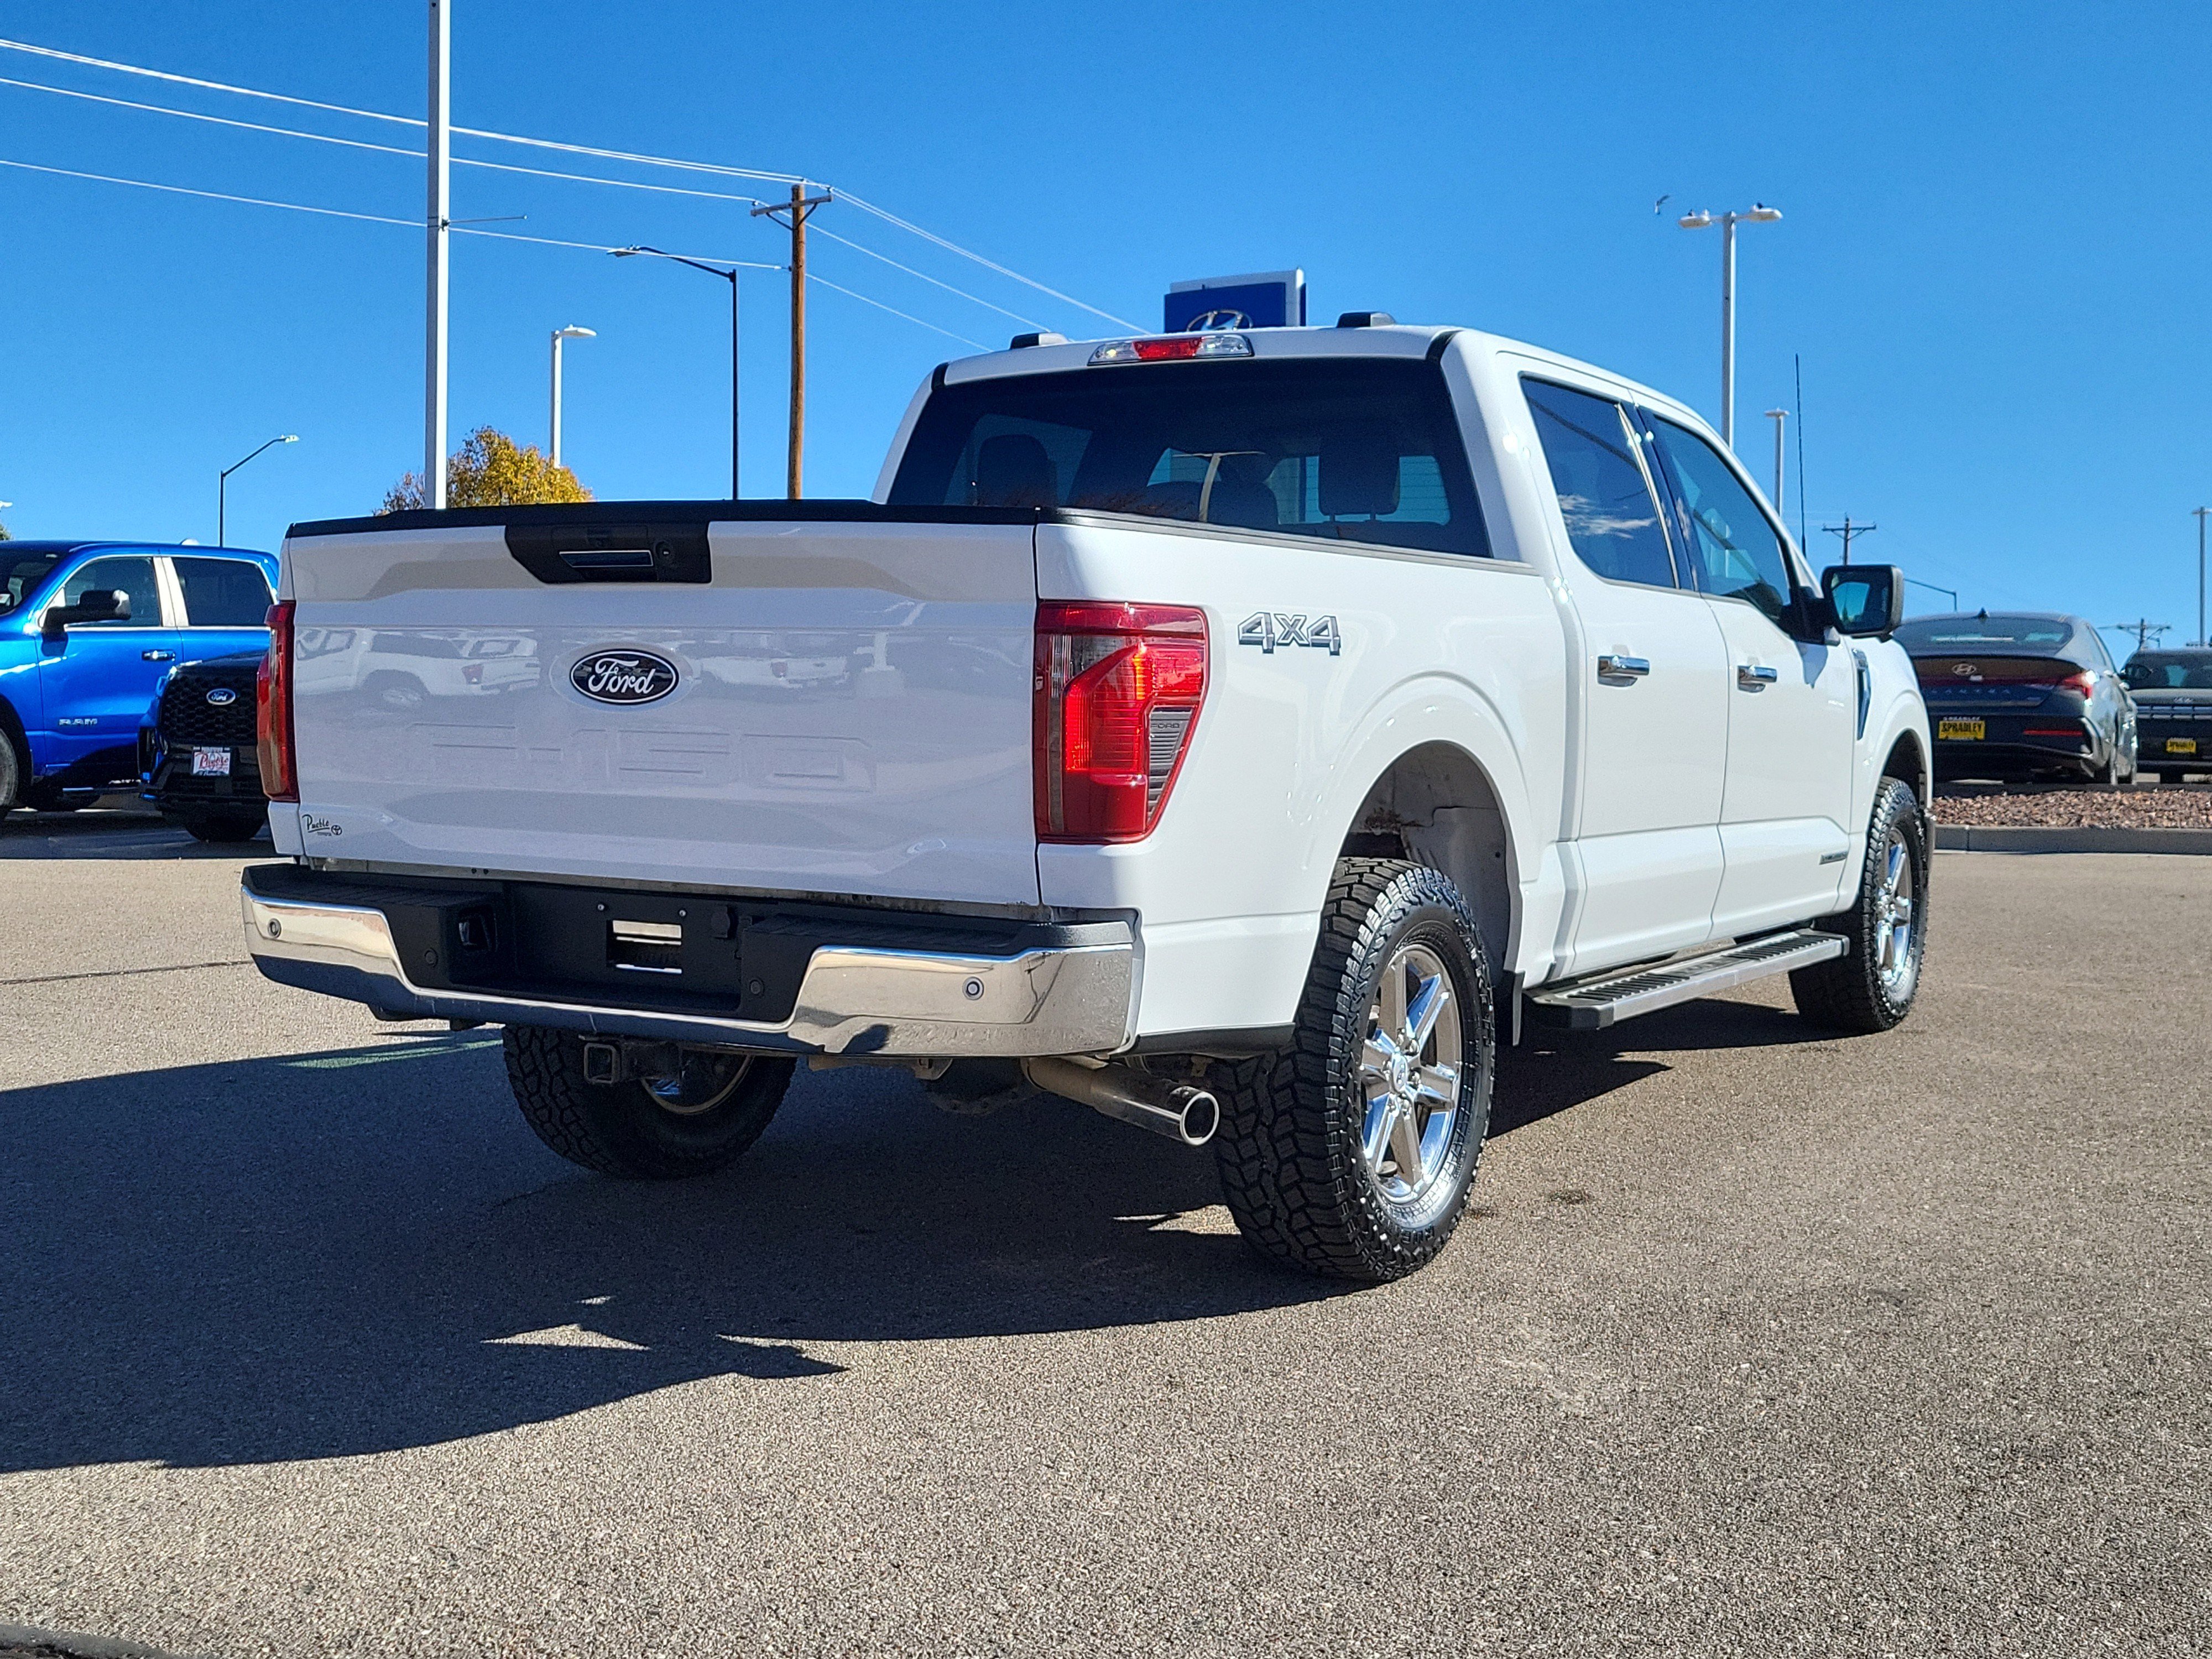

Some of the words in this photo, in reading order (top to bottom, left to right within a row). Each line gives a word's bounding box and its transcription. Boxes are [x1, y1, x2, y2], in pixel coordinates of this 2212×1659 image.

[588, 658, 656, 694] Ford
[211, 691, 228, 701] Ford
[1941, 722, 1983, 732] SPRADLEY
